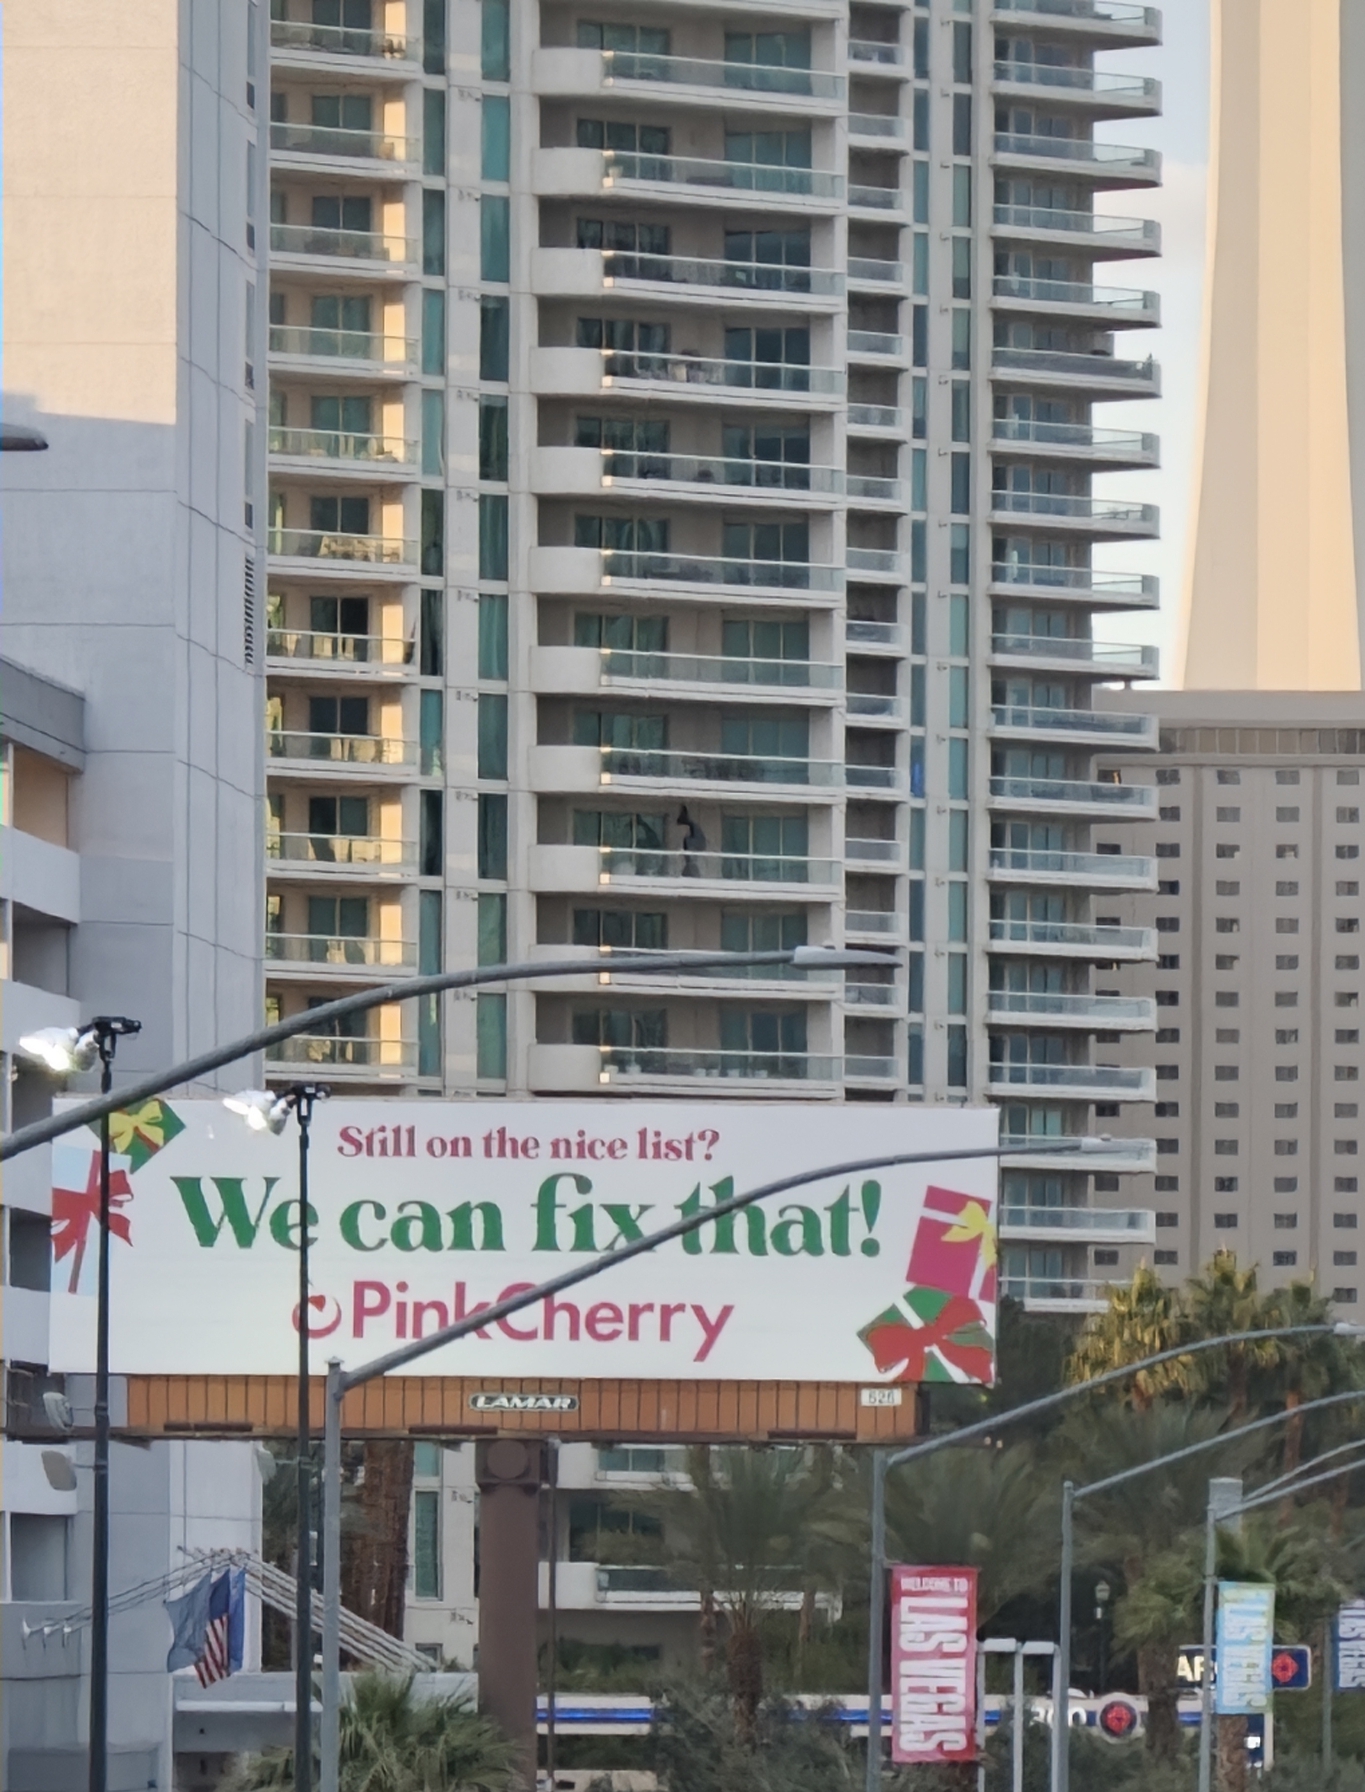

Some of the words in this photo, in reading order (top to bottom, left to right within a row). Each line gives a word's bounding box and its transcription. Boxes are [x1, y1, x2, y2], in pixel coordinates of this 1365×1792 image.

[338, 1125, 416, 1158] Still
[426, 1135, 473, 1158] on
[482, 1127, 540, 1160] the
[549, 1129, 628, 1160] nice
[637, 1127, 720, 1161] list?
[169, 1176, 319, 1250] We
[340, 1200, 506, 1252] can
[530, 1172, 656, 1252] fix
[673, 1175, 882, 1258] that!
[352, 1280, 735, 1362] PinkCherry
[476, 1395, 572, 1409] LAMAR
[900, 1596, 968, 1652] LAS
[900, 1659, 967, 1751] VEGAS
